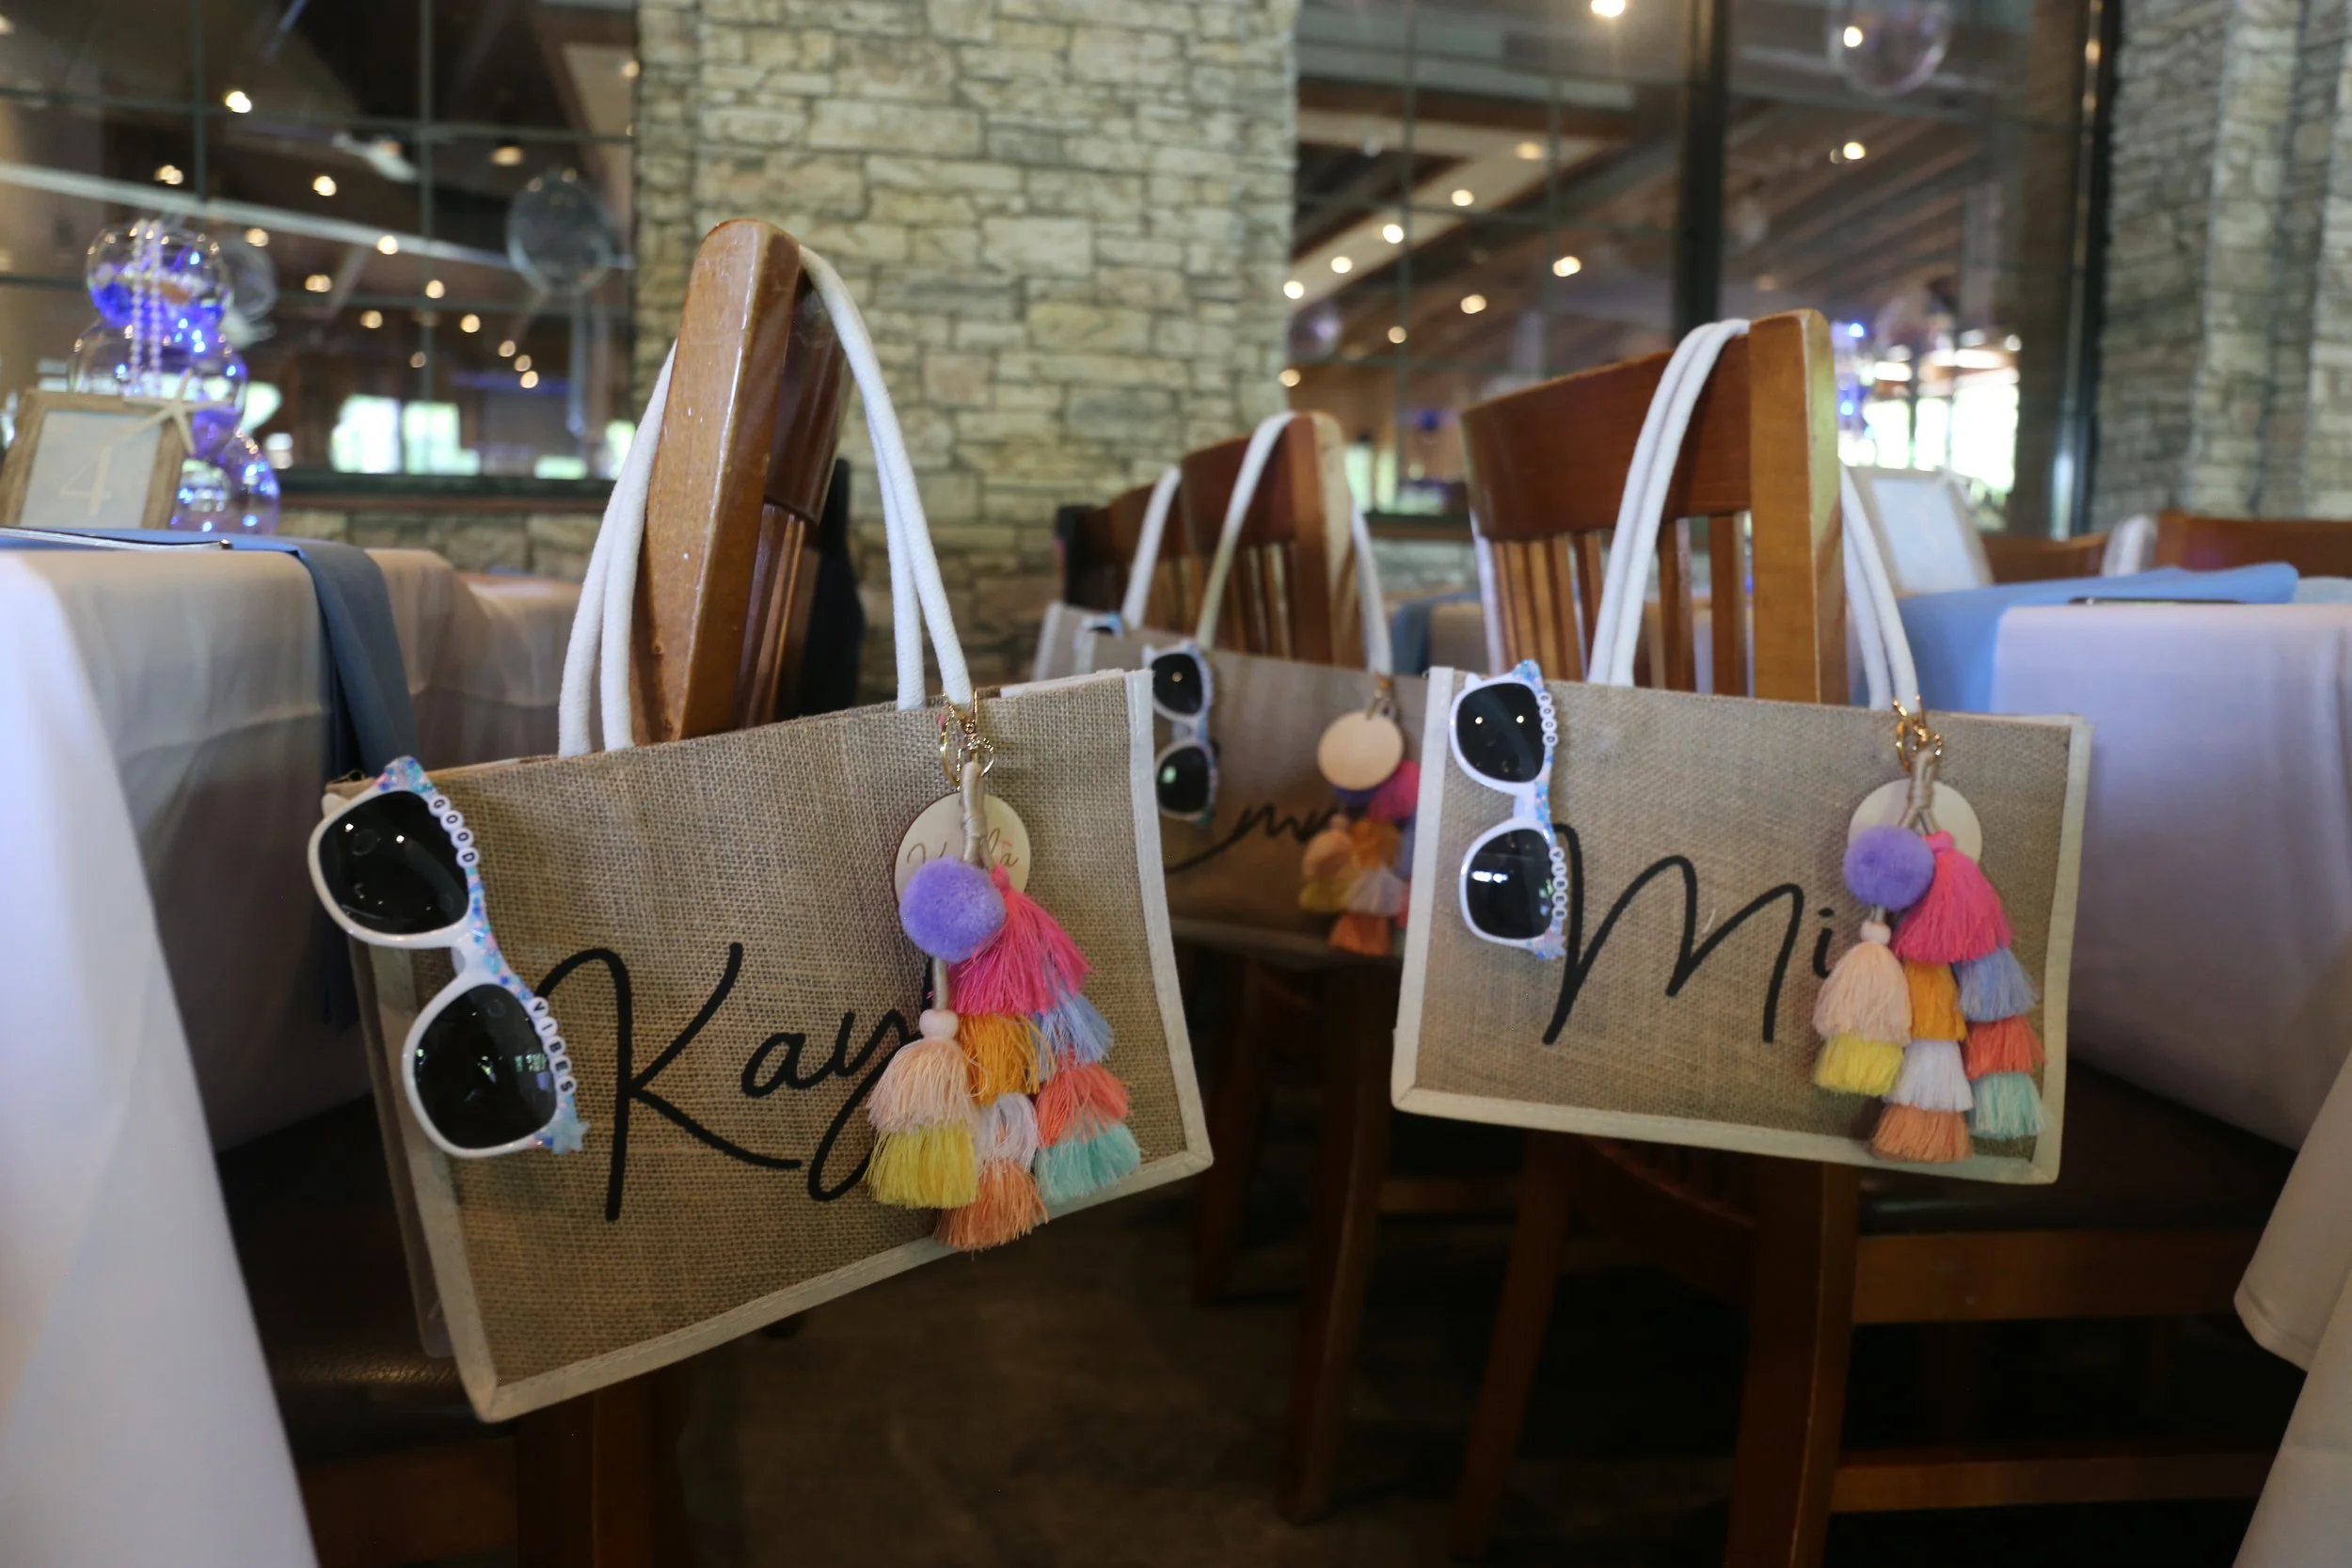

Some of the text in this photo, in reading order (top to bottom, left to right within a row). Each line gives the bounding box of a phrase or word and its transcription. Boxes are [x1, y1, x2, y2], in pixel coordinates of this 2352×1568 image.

[59, 443, 113, 517] 4
[1538, 694, 1566, 918] GOOD VIBES
[432, 797, 575, 1093] GOOD VIBES
